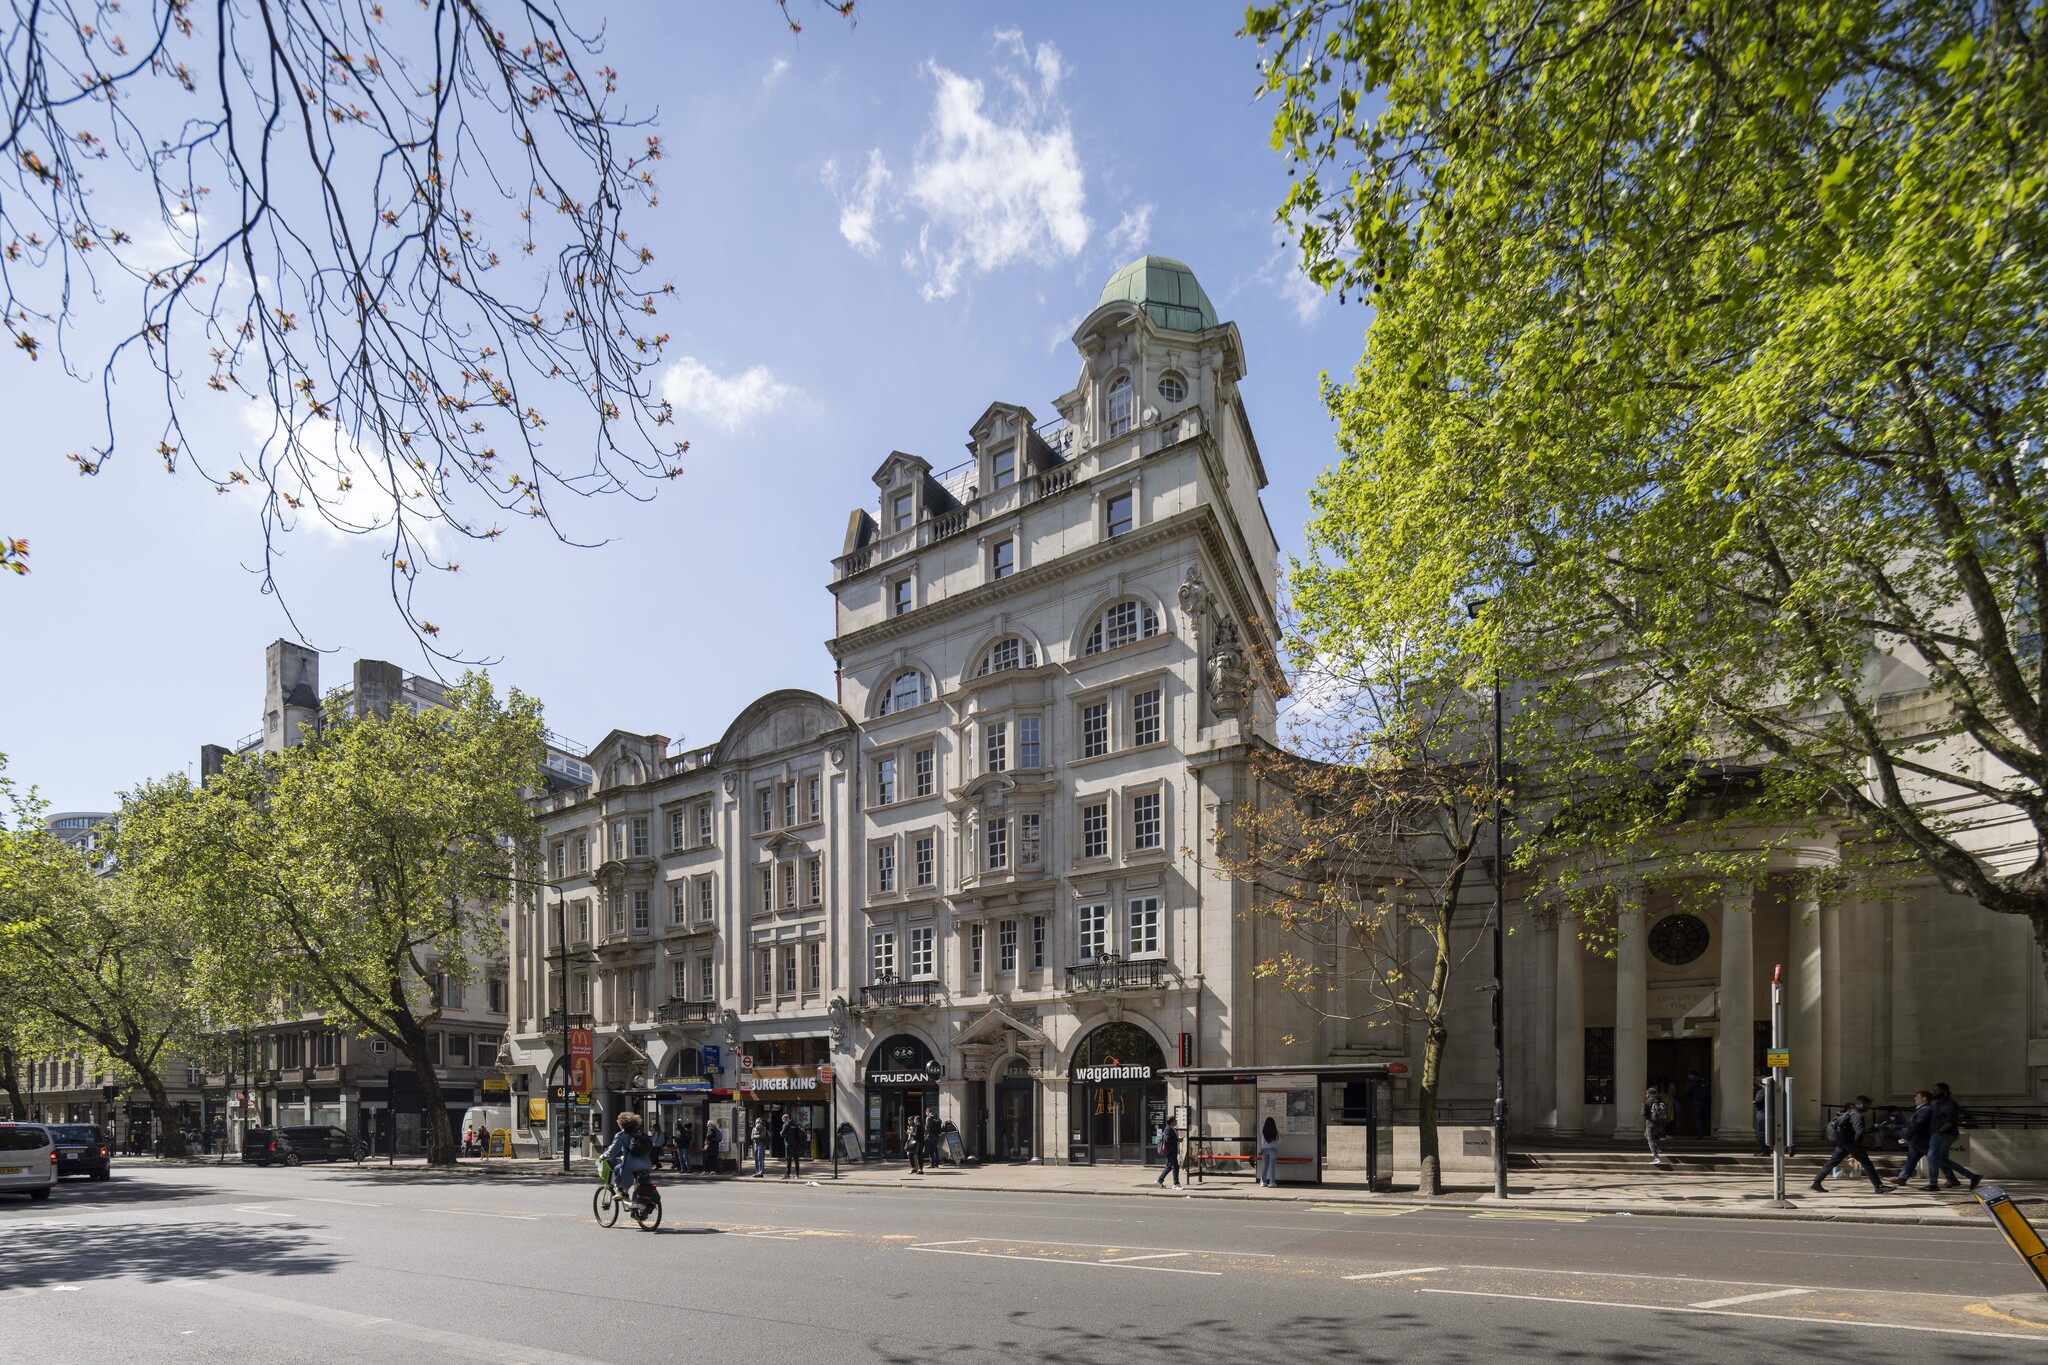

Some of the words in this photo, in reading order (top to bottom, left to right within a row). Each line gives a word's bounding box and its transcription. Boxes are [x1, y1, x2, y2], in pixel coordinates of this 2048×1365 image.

[1009, 1067, 1023, 1075] 121
[1076, 1066, 1151, 1082] wagamama
[751, 1078, 788, 1091] BURGER
[790, 1077, 816, 1090] KING
[871, 1073, 929, 1083] TRUEDAN
